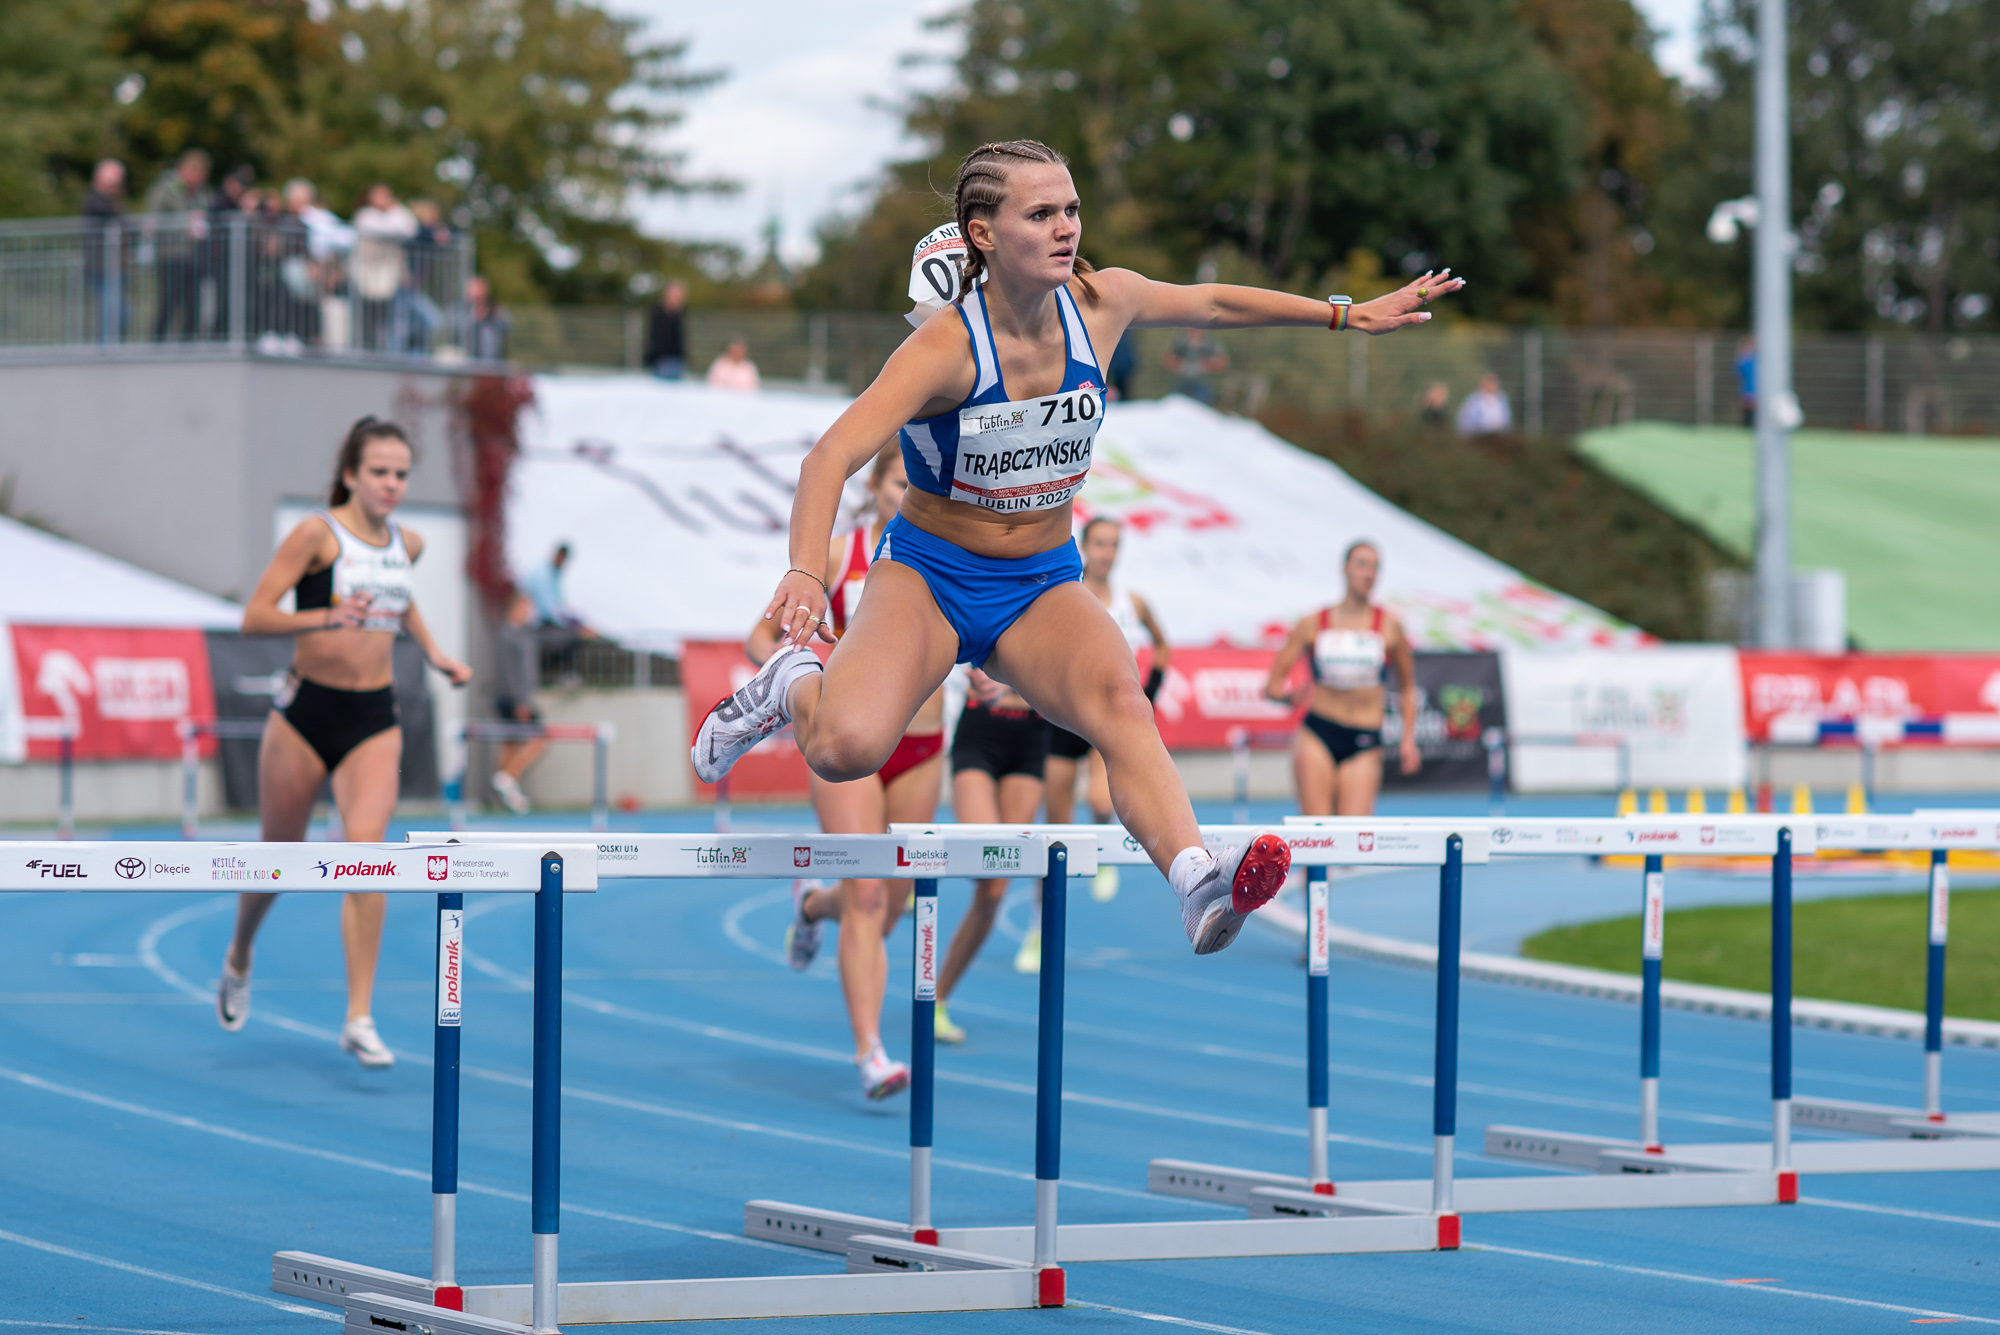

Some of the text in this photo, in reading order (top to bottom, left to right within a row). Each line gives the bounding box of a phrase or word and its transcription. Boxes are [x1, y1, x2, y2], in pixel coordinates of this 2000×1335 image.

[1040, 393, 1096, 427] 710
[963, 436, 1091, 480] TRĄBCZYŃSKA
[977, 488, 1071, 510] LUBLIN 2022
[624, 844, 639, 853] U16
[1289, 836, 1335, 850] polanik
[685, 847, 730, 863] lublin
[1000, 848, 1020, 860] AZS
[212, 856, 246, 868] NESTLÉ for
[1000, 861, 1020, 869] LUBLIN
[41, 864, 88, 878] FUEL
[154, 863, 190, 876] Okęcie
[212, 870, 270, 880] HEALTHIER KIDS
[334, 861, 397, 880] polanik
[452, 870, 475, 879] Sportu
[479, 870, 509, 879] Turystyki
[921, 924, 934, 981] polanik
[444, 939, 460, 1004] polanik
